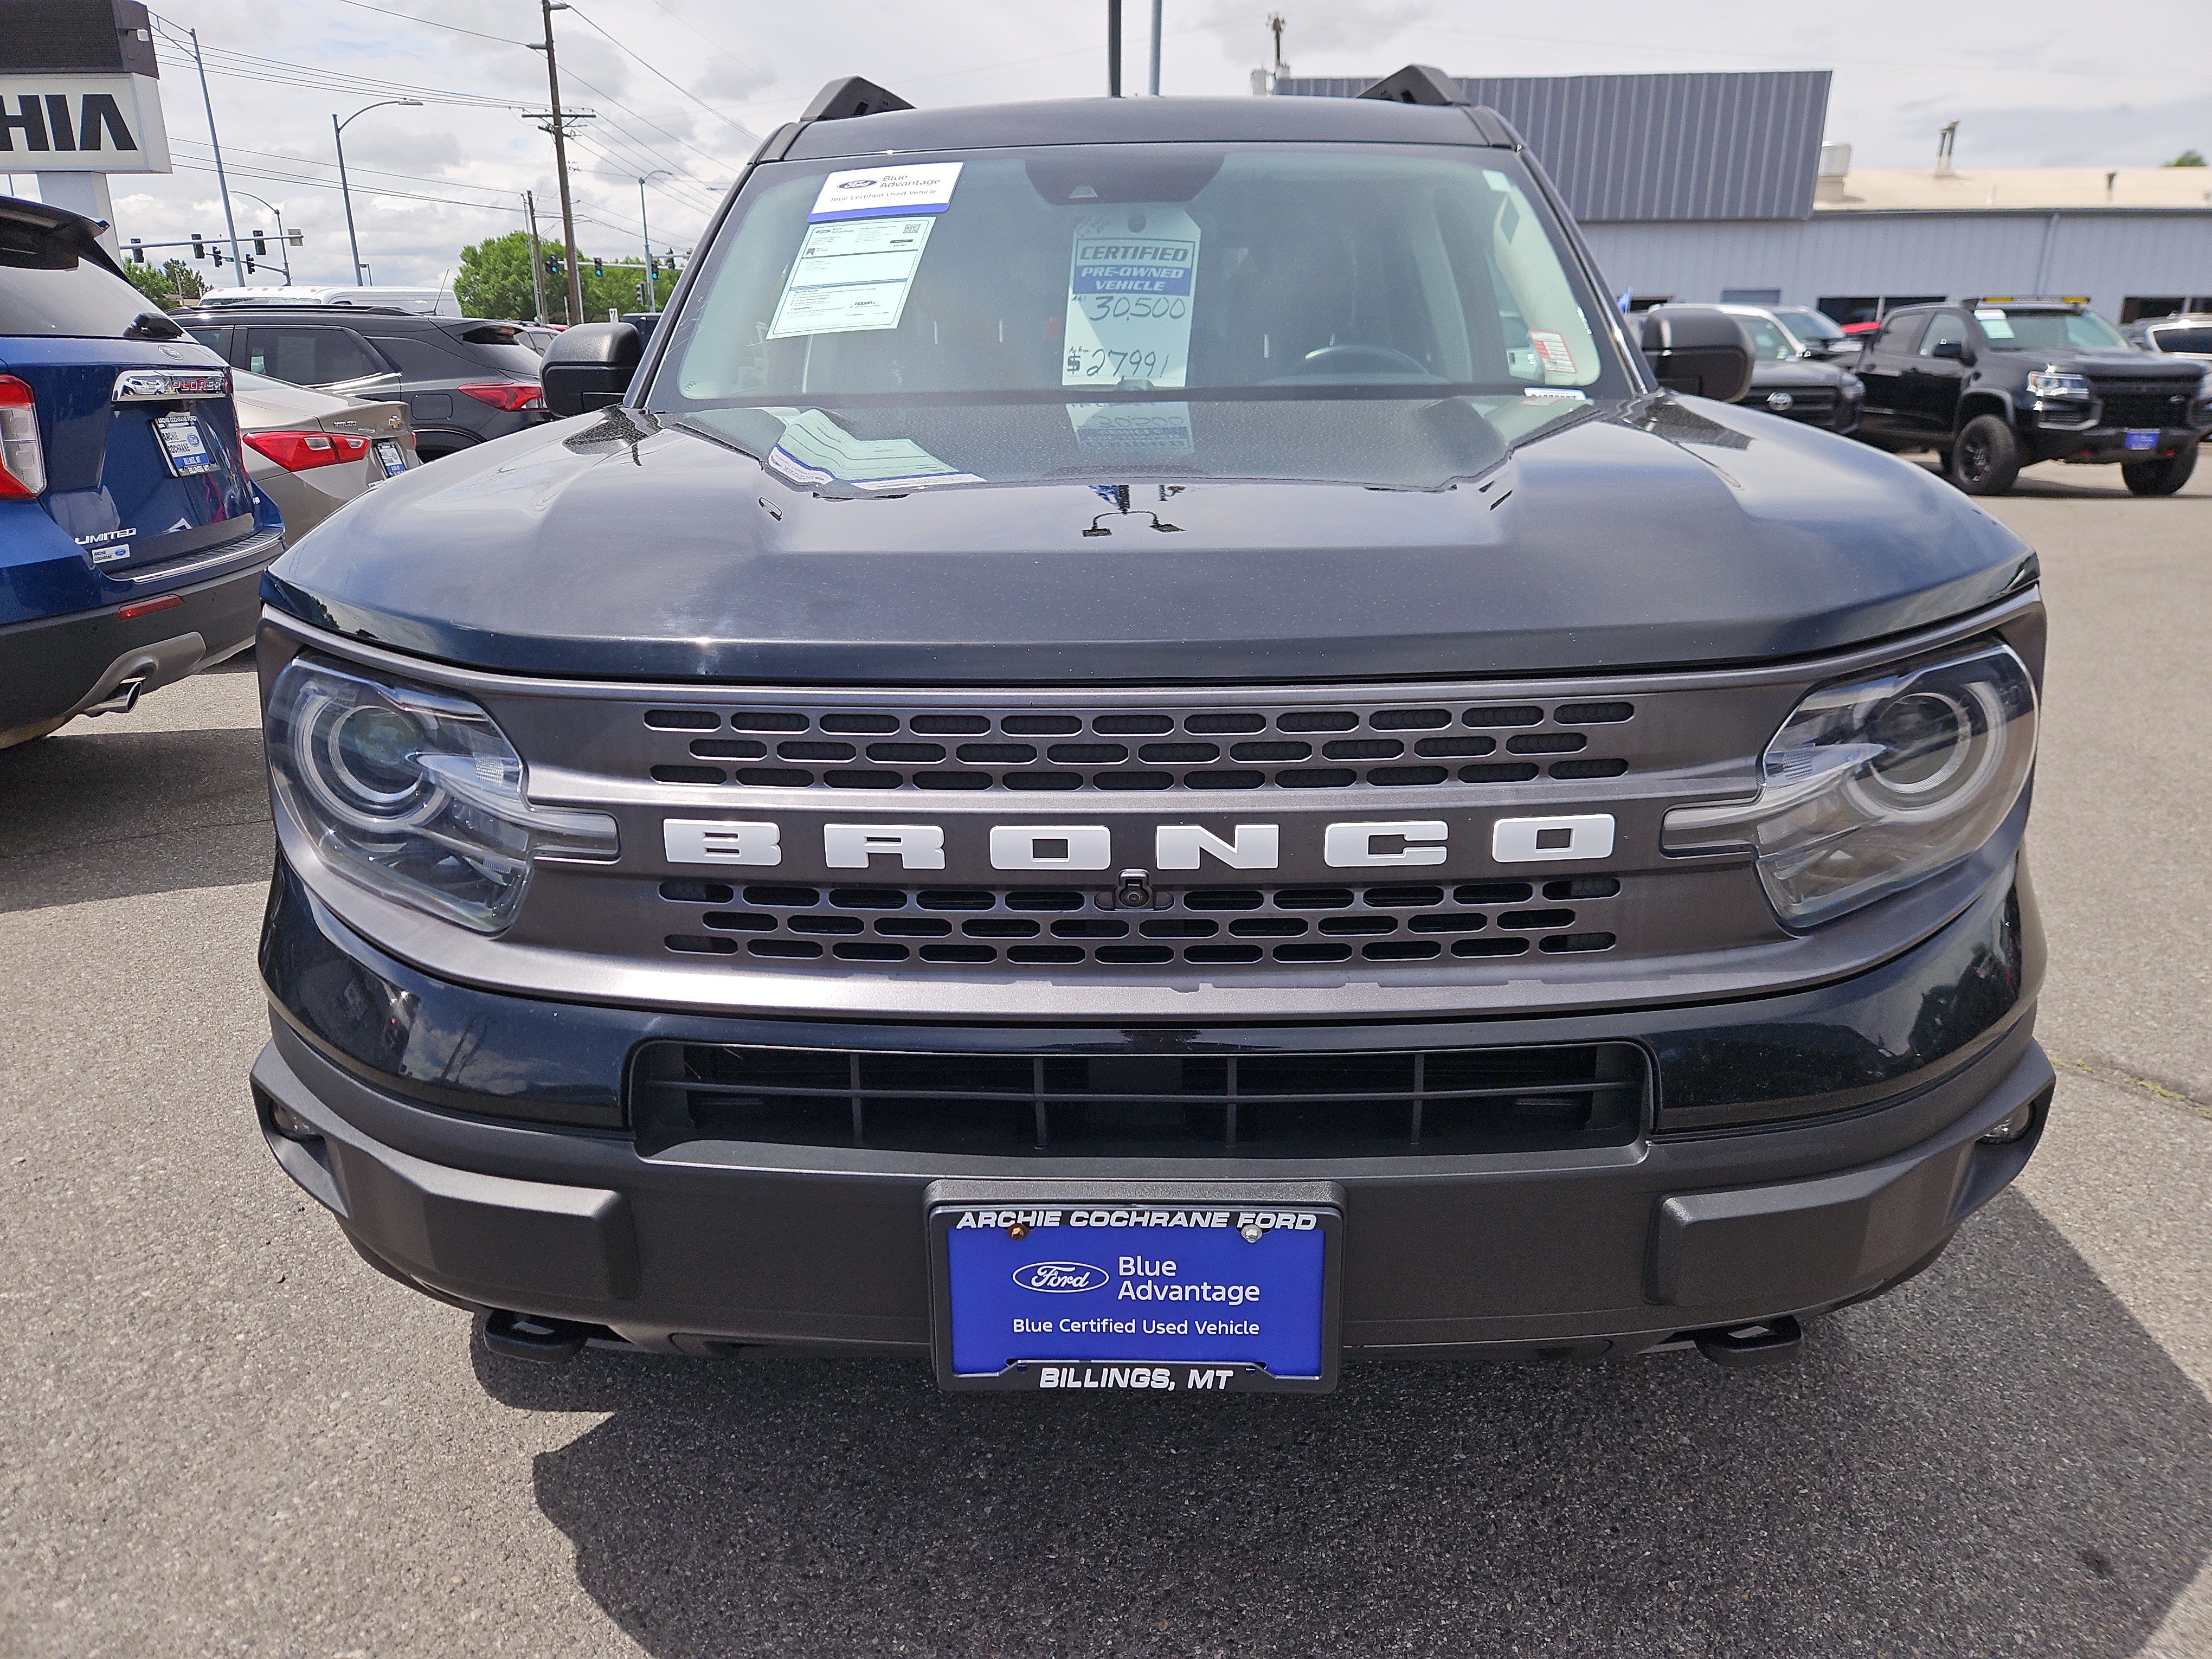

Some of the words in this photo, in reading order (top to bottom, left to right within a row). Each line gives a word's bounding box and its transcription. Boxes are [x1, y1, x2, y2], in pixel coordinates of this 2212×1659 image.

[844, 181, 871, 189] Ford
[880, 179, 941, 188] Advantage
[1079, 246, 1189, 261] CERTIFIED
[1081, 267, 1184, 279] PRE-OWNED
[1095, 280, 1166, 292] VEHICLE
[1089, 296, 1186, 321] 30,500
[147, 381, 222, 391] EXPLORER
[162, 432, 179, 441] ARCHIE
[74, 528, 137, 544] LIMITED
[663, 814, 1616, 870] BRONCO
[956, 1211, 1062, 1229] ARCHIE
[1069, 1211, 1227, 1229] COCHRANE
[1236, 1212, 1317, 1231] FORD
[1118, 1256, 1176, 1277] Blue
[1031, 1264, 1091, 1289] Ford
[1117, 1279, 1261, 1306] Advantage
[1013, 1318, 1053, 1334] Blue
[1059, 1317, 1136, 1334] Certified
[1142, 1319, 1188, 1335] Used
[1194, 1320, 1260, 1336] Vehicle
[1039, 1367, 1175, 1391] BILLINGS,
[1187, 1368, 1234, 1390] MT
